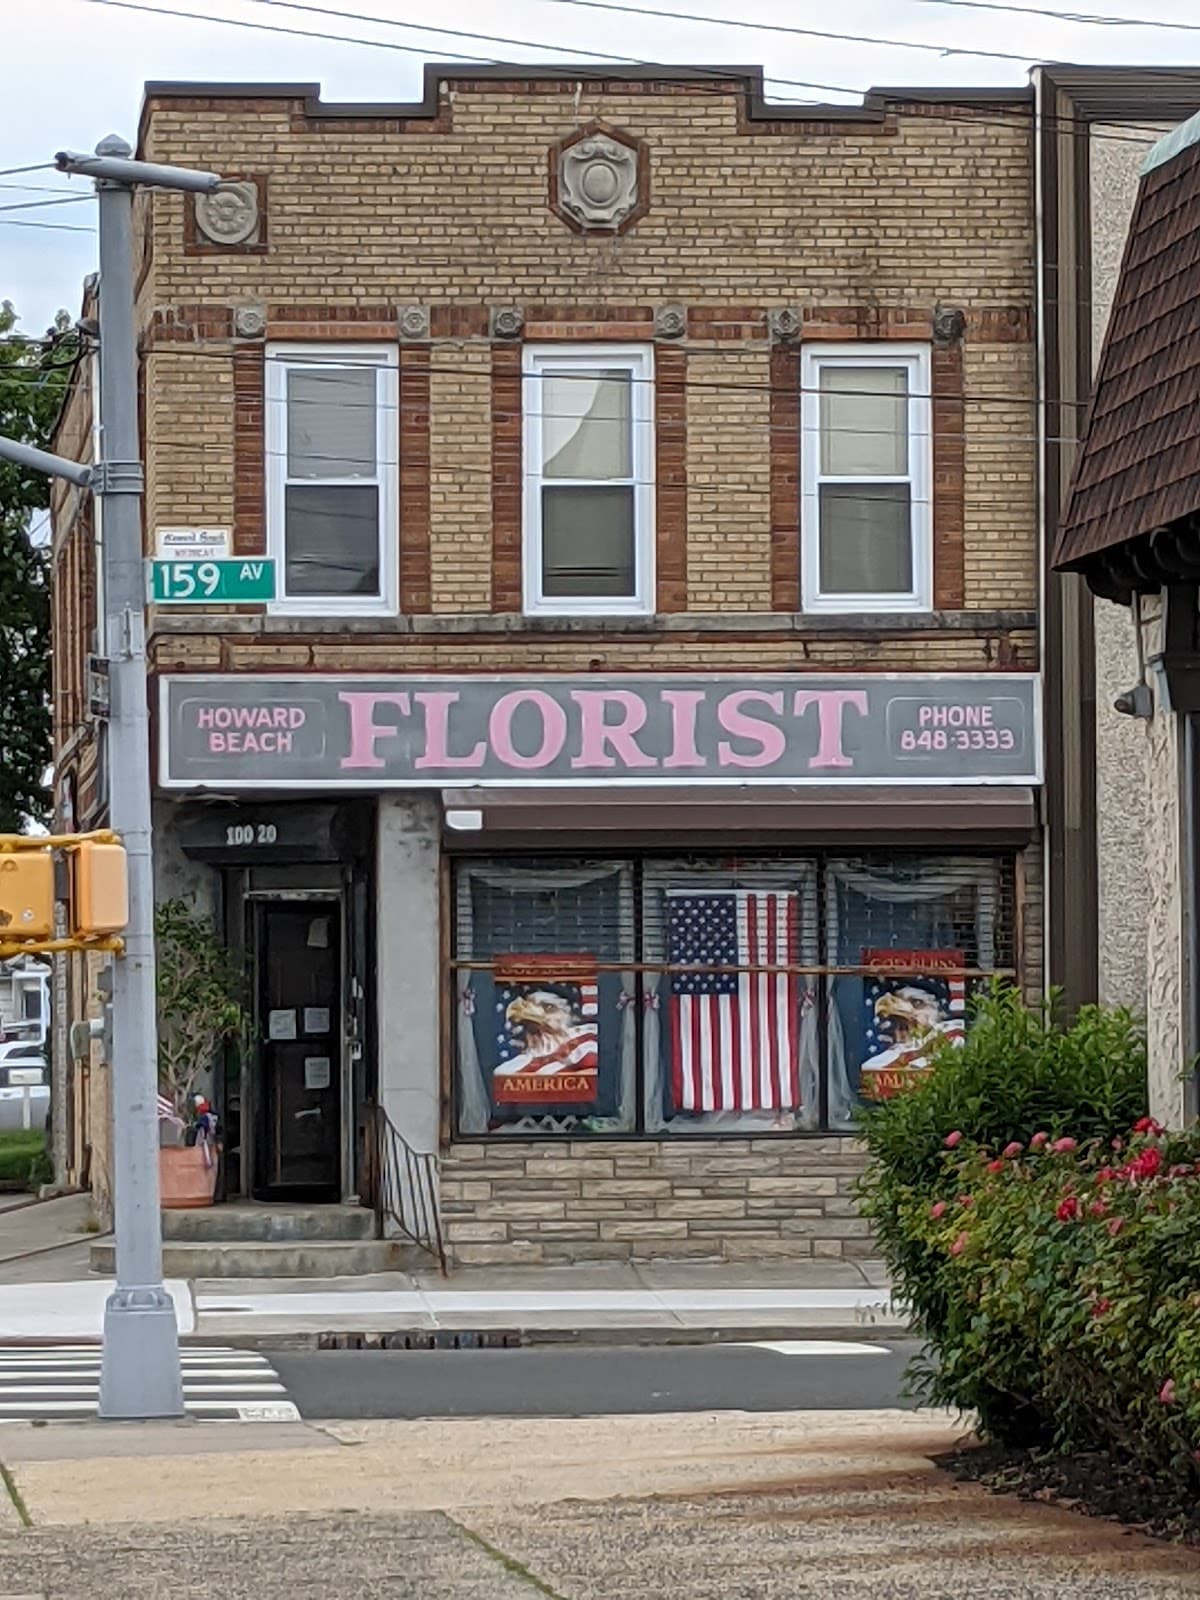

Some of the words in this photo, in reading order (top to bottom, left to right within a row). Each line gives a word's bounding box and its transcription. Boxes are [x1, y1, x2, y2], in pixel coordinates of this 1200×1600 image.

[161, 562, 220, 598] 159
[239, 562, 264, 581] AV
[197, 707, 306, 729] HOWARD
[918, 704, 994, 728] PHONE
[338, 689, 870, 769] FLORIST
[208, 731, 293, 753] BEACH
[226, 824, 254, 846] 100
[257, 823, 277, 844] 20
[503, 1076, 590, 1092] AMERICA
